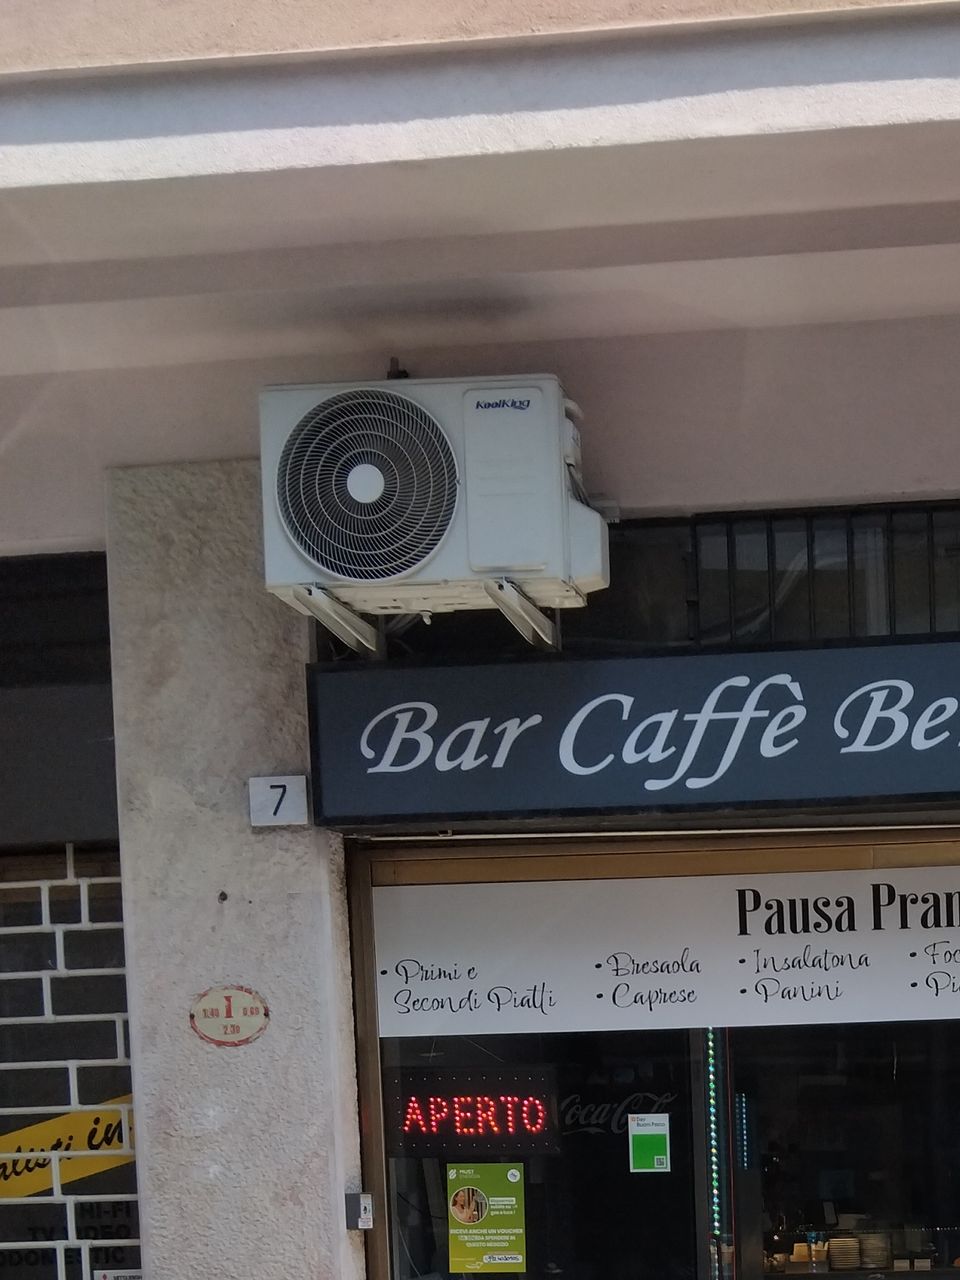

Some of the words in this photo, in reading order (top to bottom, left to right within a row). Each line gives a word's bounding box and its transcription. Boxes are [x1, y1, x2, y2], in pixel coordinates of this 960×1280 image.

[475, 398, 531, 411] KoolKing
[360, 701, 543, 775] Bar
[558, 673, 807, 790] Caffè
[269, 784, 287, 816] 7
[736, 888, 857, 936] Pausa
[395, 959, 462, 985] Primi
[467, 966, 478, 981] e
[606, 947, 702, 977] Bresaola
[753, 944, 871, 974] Insalatona
[394, 989, 482, 1014] Secondi
[487, 982, 557, 1016] Piatti
[612, 983, 698, 1012] Caprese
[755, 977, 844, 1003] Panini
[403, 1096, 545, 1134] APERTO
